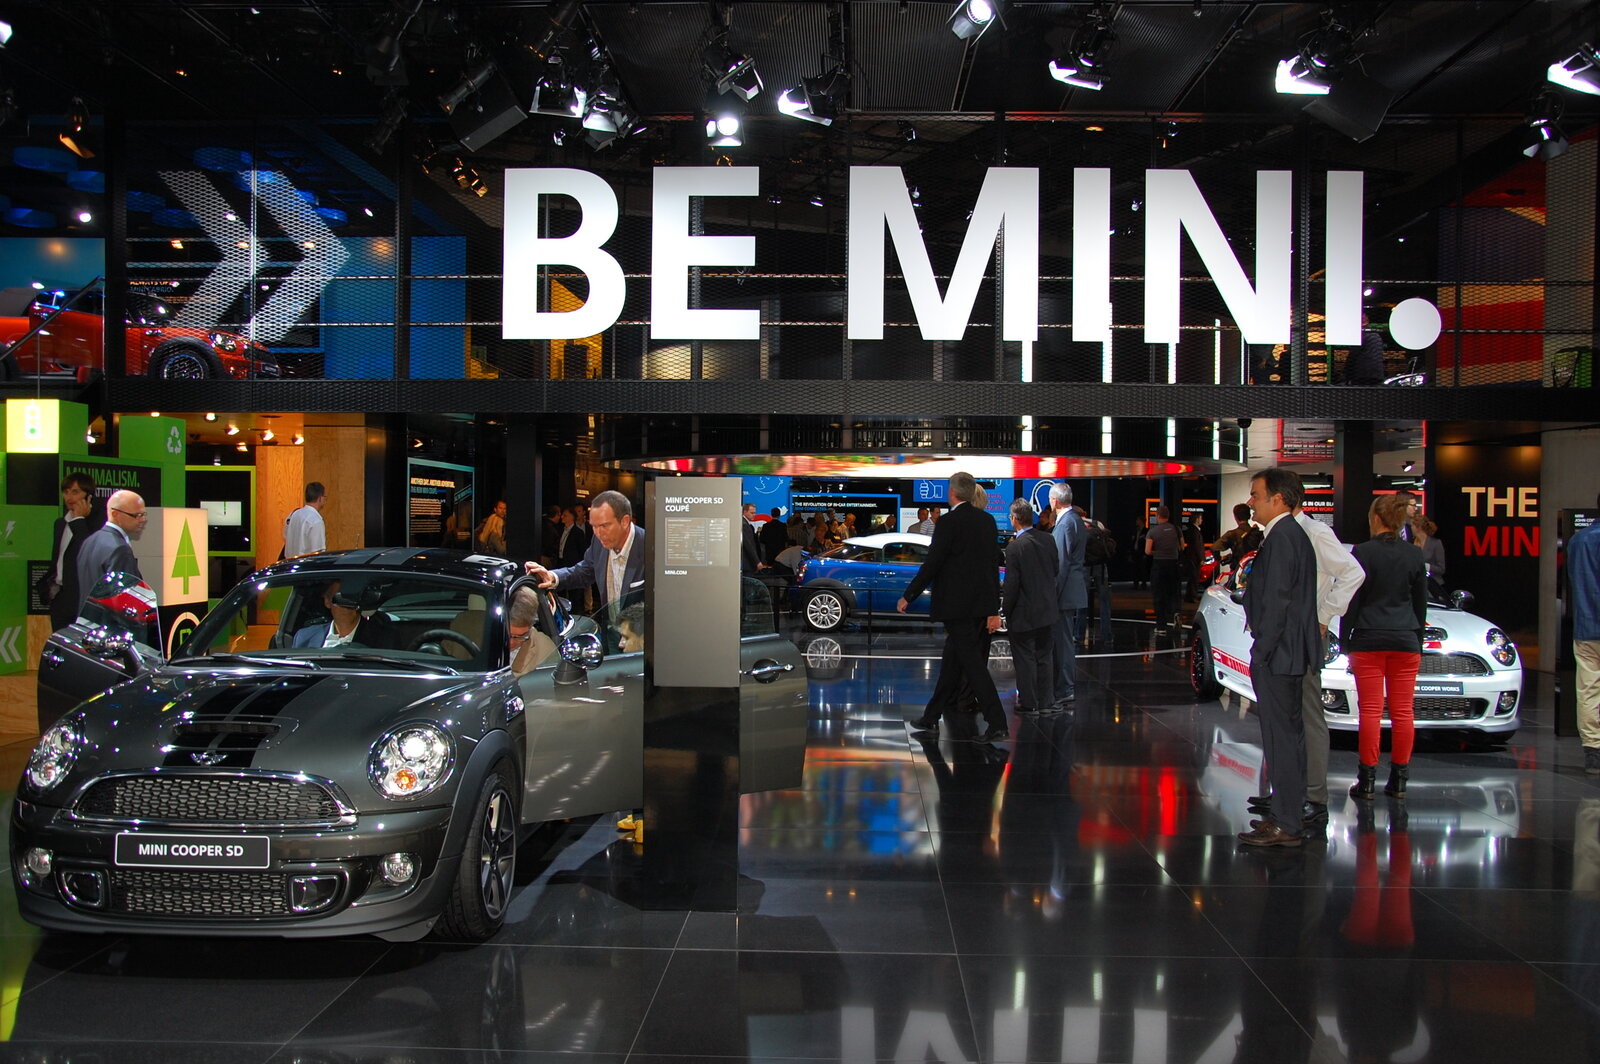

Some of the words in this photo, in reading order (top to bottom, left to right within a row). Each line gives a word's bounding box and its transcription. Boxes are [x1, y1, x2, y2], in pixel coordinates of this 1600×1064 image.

[502, 166, 760, 340] BE
[848, 166, 1442, 350] MINI.
[665, 504, 690, 512] COUPÉ
[1461, 487, 1538, 517] THE
[138, 843, 168, 856] MINI
[170, 844, 223, 857] COOPER
[225, 845, 244, 857] SD
